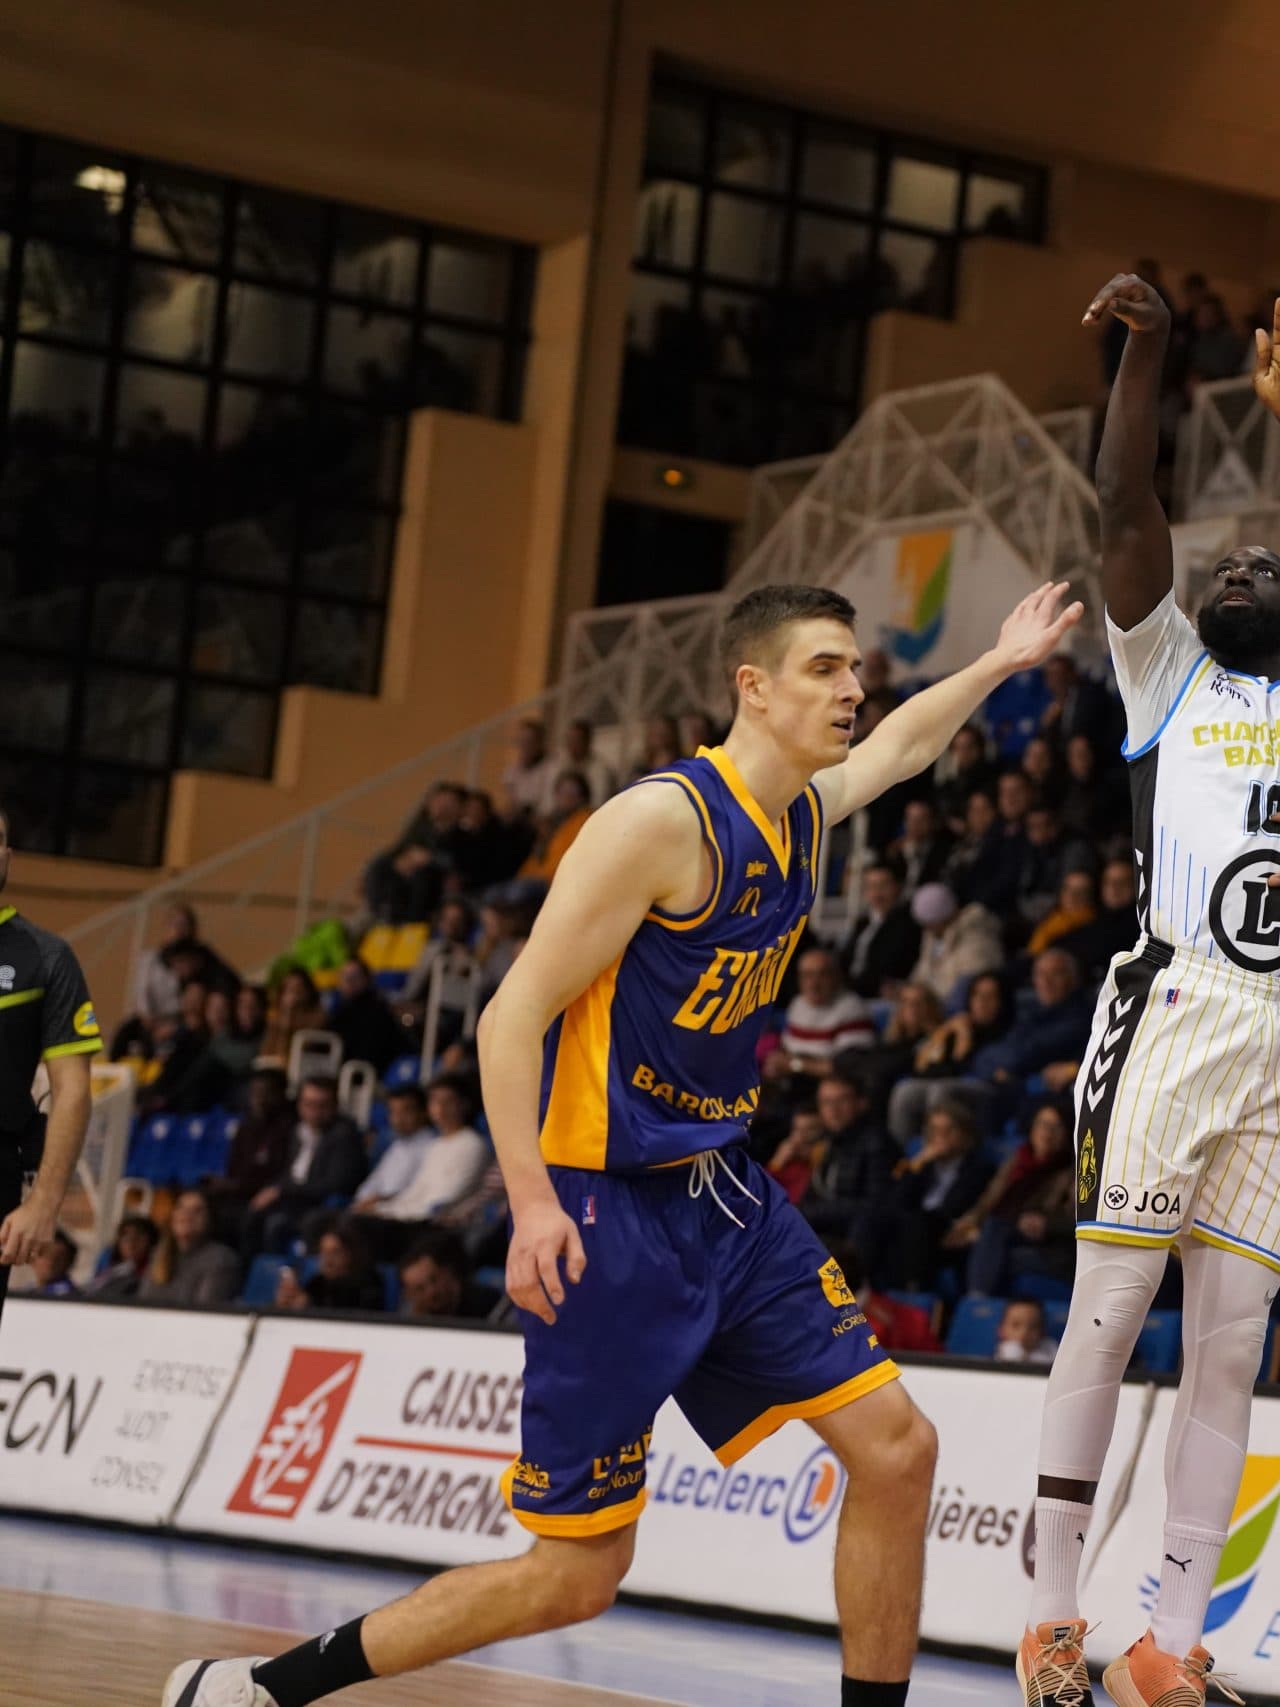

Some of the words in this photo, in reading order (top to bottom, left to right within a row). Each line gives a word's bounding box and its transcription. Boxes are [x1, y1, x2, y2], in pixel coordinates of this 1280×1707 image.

[1134, 1190, 1181, 1215] JOA
[401, 1366, 525, 1435] CAISSE
[646, 1452, 788, 1519] Leclerc
[925, 1486, 1019, 1548] ières
